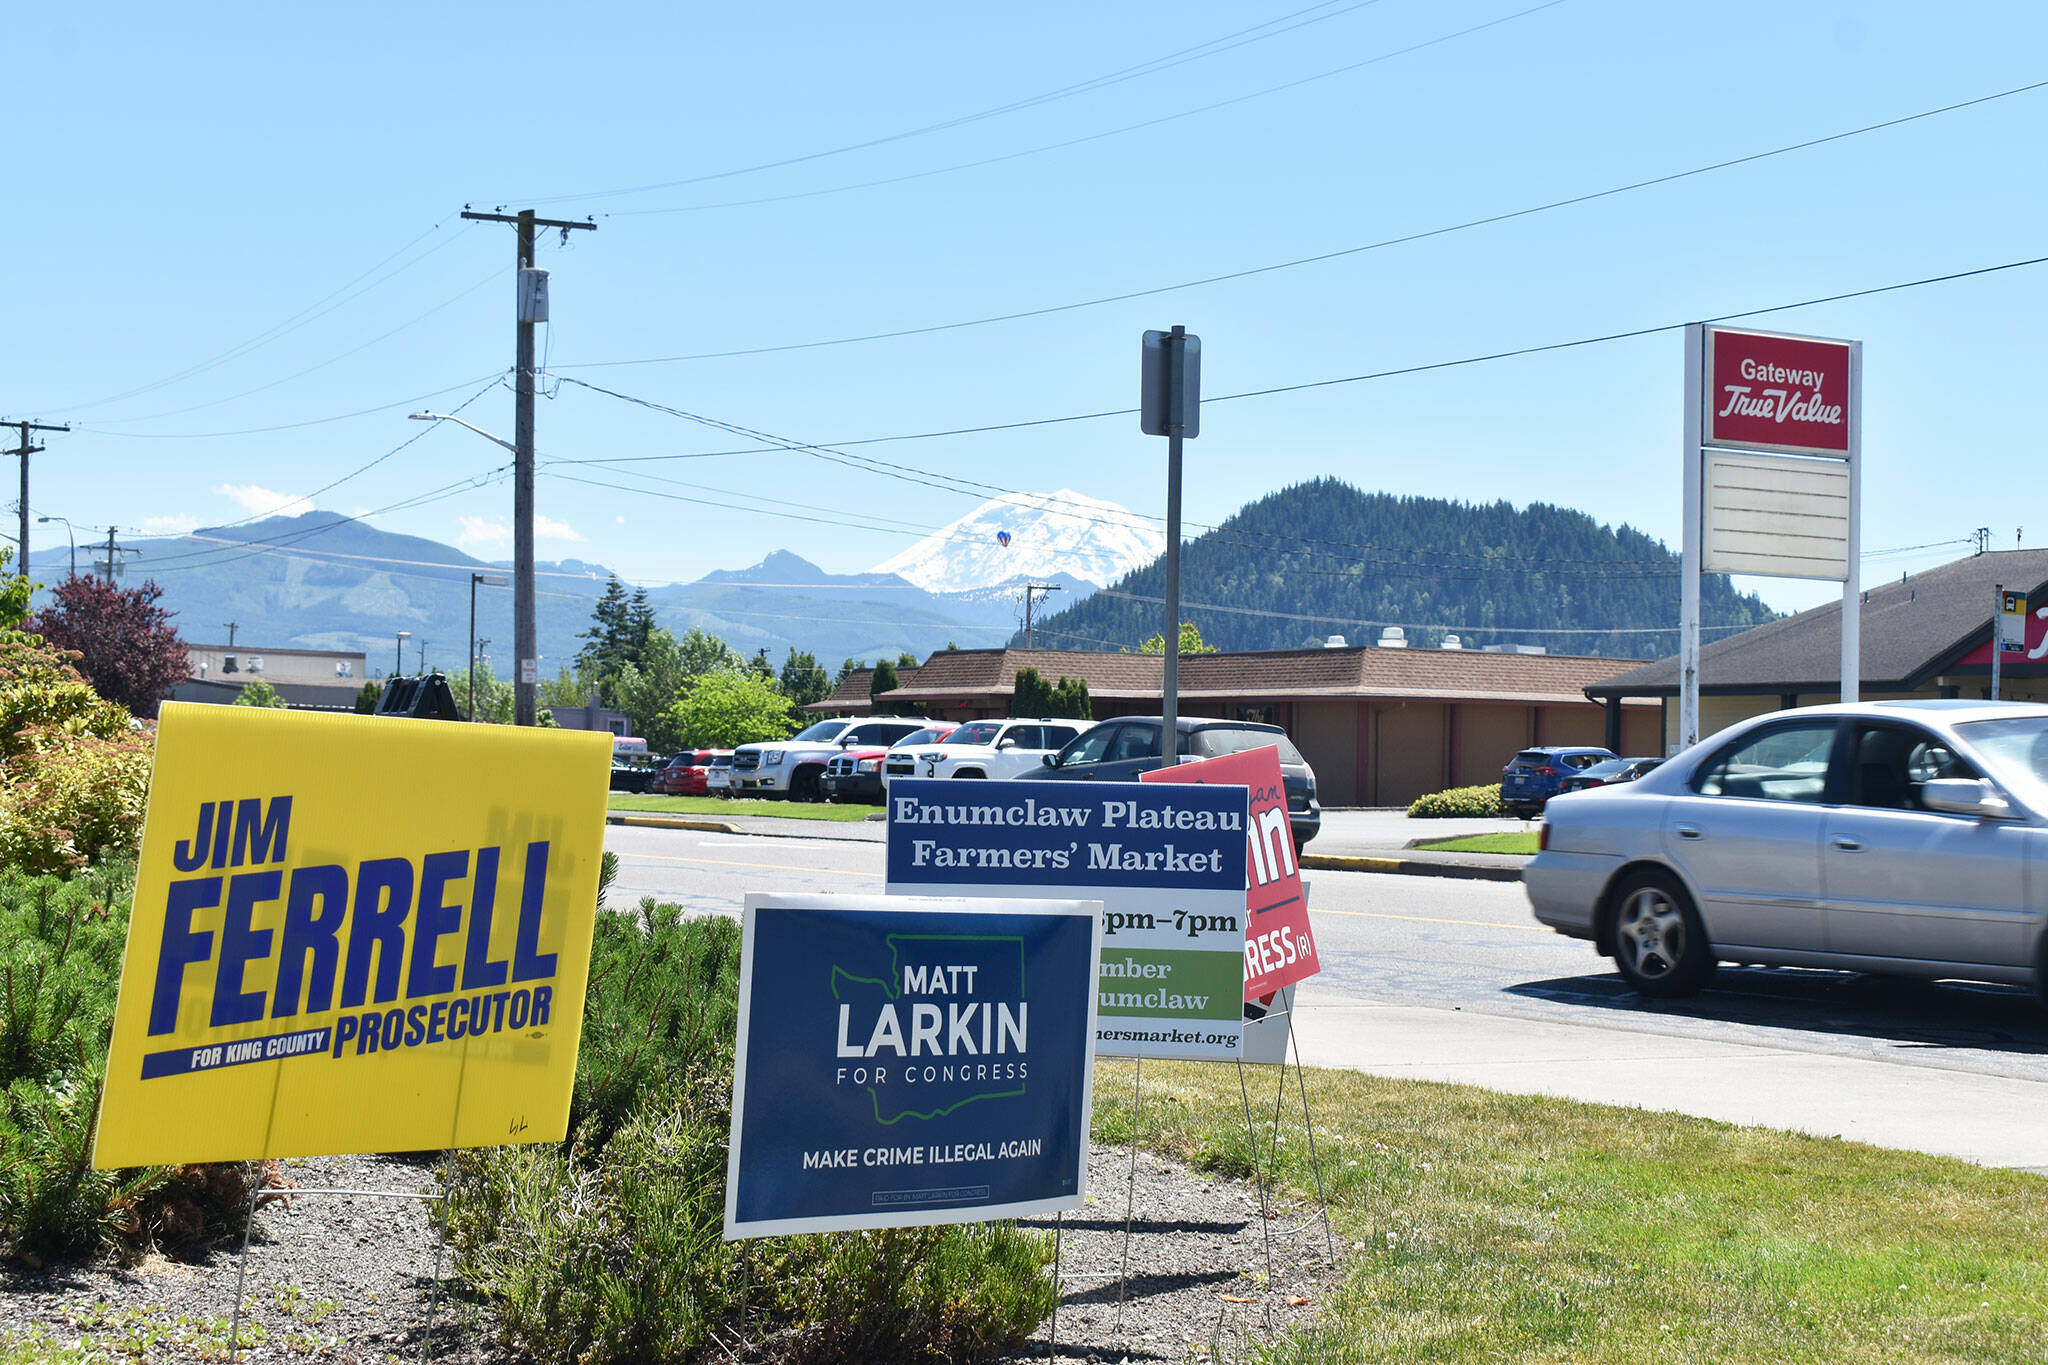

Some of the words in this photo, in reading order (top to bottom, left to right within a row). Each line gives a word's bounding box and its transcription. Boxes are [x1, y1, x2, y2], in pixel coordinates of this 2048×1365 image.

[1740, 358, 1824, 391] Gateway
[894, 797, 1092, 827] Enumclaw
[1101, 800, 1241, 831] Plateau
[173, 795, 293, 872] JIM
[912, 839, 1078, 869] Farmers’
[1087, 843, 1223, 872] Market
[147, 840, 558, 1037] FERRELL
[1244, 926, 1296, 982] RESS
[1296, 931, 1312, 959] (R)
[904, 965, 978, 995] MATT
[1099, 957, 1172, 979] mber
[1098, 988, 1208, 1010] umclaw
[333, 985, 553, 1058] PROSECUTOR
[837, 1002, 1028, 1058] LARKIN
[191, 1047, 221, 1069] FOR
[225, 1041, 262, 1063] KING
[266, 1031, 325, 1057] COUNTY
[837, 1067, 887, 1085] FOR
[905, 1063, 1028, 1084] CONGRESS
[802, 1149, 858, 1169] MAKE
[863, 1146, 924, 1167] CRIME
[929, 1142, 995, 1164] ILLEGAL
[998, 1138, 1042, 1158] AGAIN
